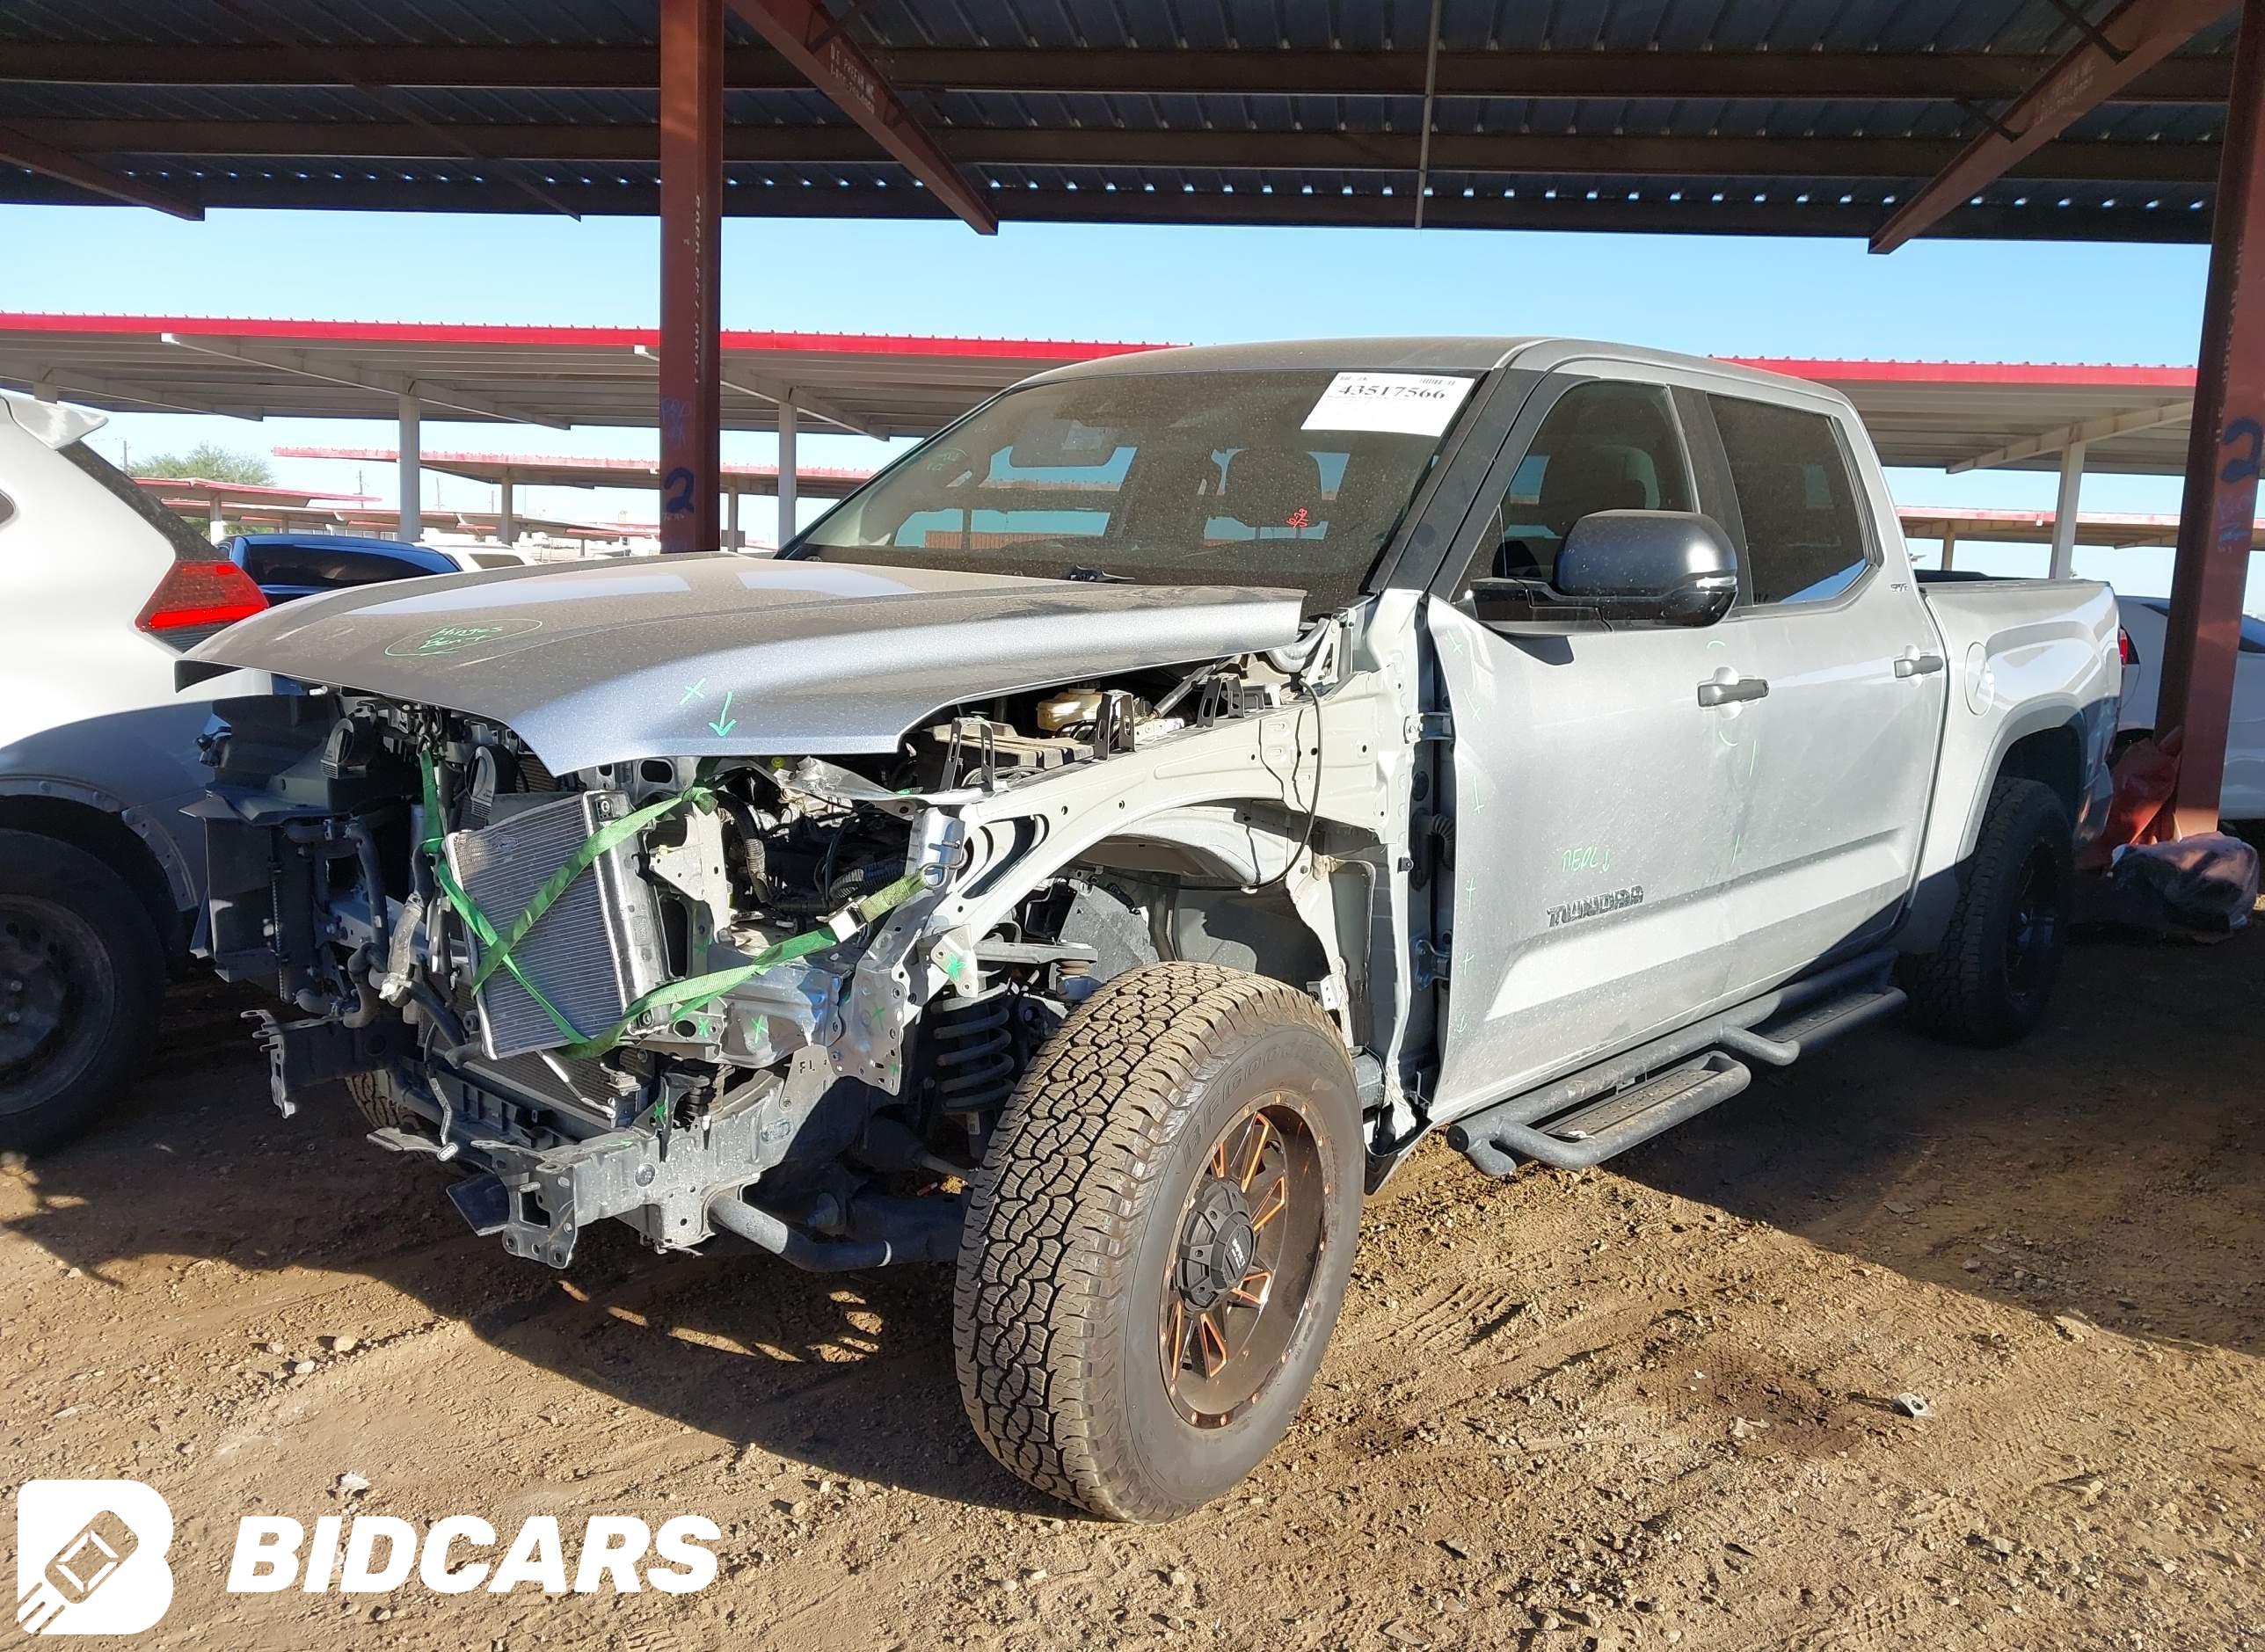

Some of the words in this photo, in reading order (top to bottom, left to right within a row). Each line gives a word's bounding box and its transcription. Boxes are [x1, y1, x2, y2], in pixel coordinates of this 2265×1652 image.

[1337, 383, 1446, 400] 43517566
[664, 466, 695, 513] 2
[1546, 884, 1644, 928] TUNDRA
